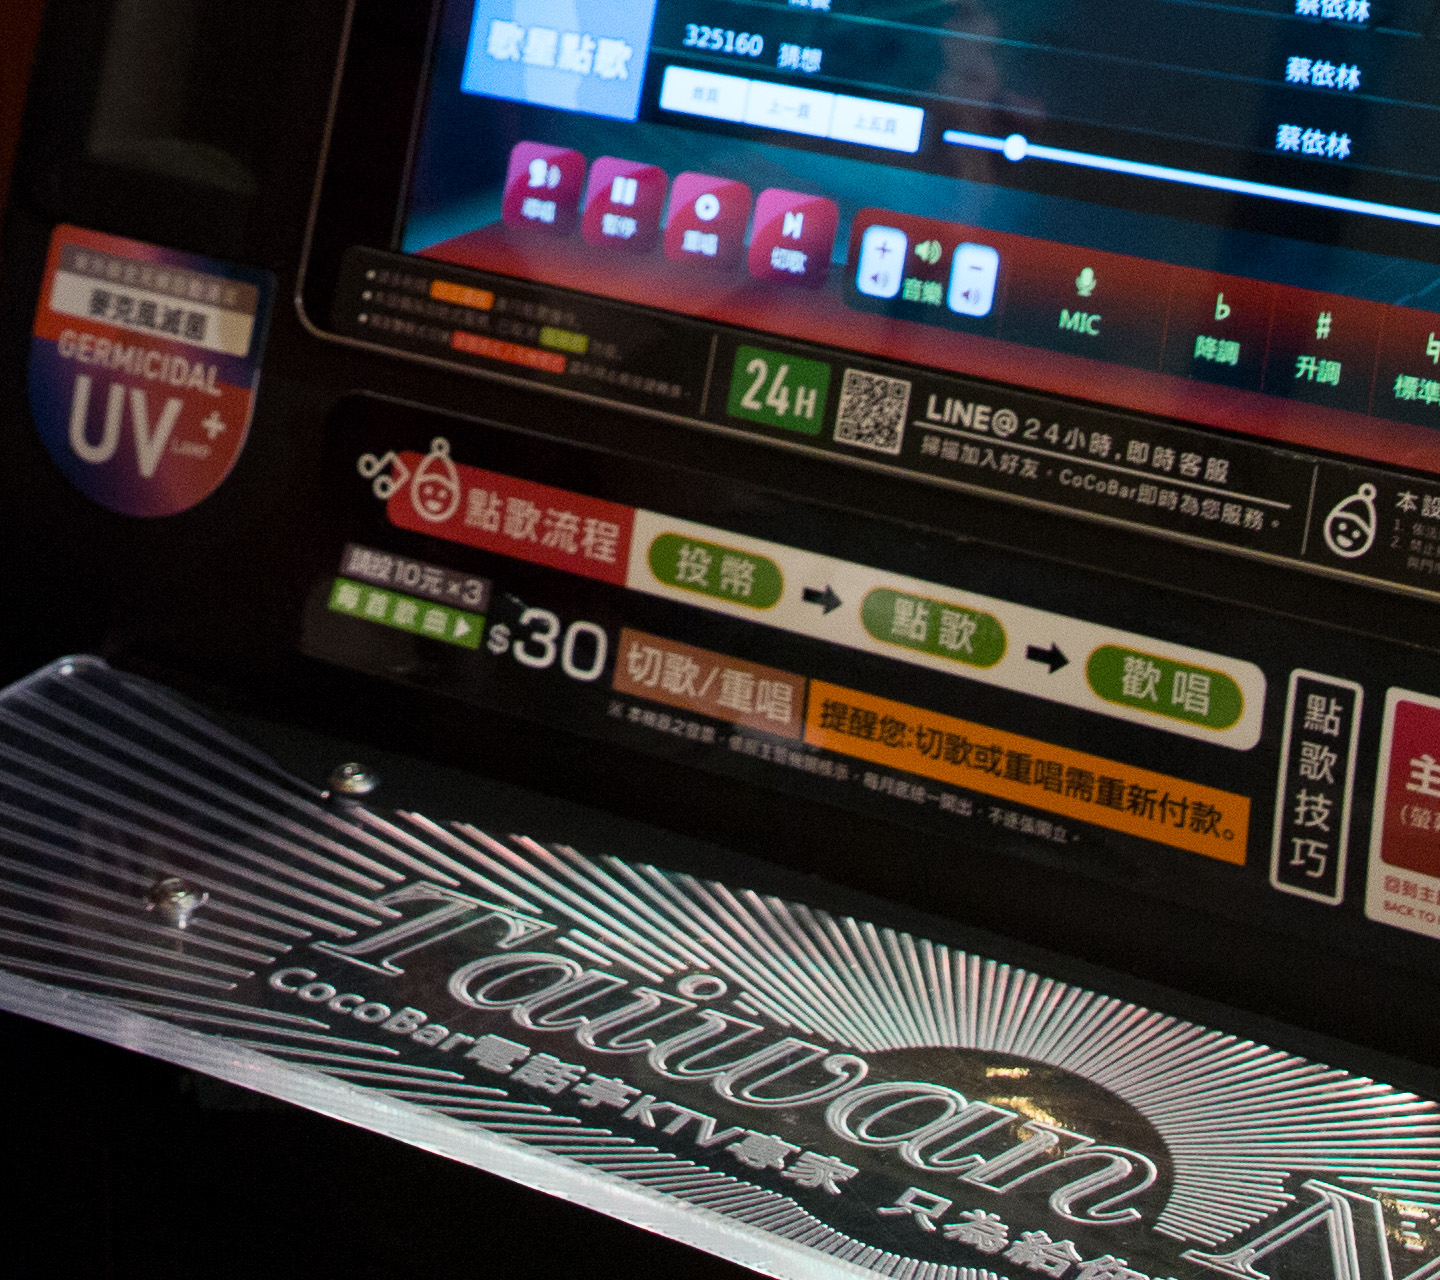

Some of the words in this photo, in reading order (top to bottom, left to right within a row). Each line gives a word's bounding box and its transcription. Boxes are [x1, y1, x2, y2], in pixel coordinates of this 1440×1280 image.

[487, 19, 633, 81] 歌星點歌
[1285, 56, 1361, 91] 蔡依林
[683, 23, 764, 57] 325160
[1276, 124, 1351, 159] 蔡依林
[770, 100, 811, 120] 上一頁
[854, 114, 898, 135] 上五頁
[901, 276, 944, 307] 音樂
[1058, 308, 1102, 336] MIC
[56, 328, 223, 397] GERMICIDAL
[1194, 333, 1241, 367] 降調
[1294, 354, 1342, 388] 升調
[740, 356, 818, 422] 24H
[925, 391, 1019, 439] LINE@
[464, 487, 622, 565] 點歌流程
[675, 541, 758, 599] 投幣
[891, 596, 978, 655] 點歌
[1121, 654, 1212, 717] 歡唱
[487, 606, 609, 682] $30
[625, 641, 796, 726] 切歌/重唱
[1289, 693, 1343, 880] 點歌技巧
[1383, 899, 1420, 922] BACK
[1422, 907, 1437, 925] TO
[311, 880, 1158, 1225] Taiwan
